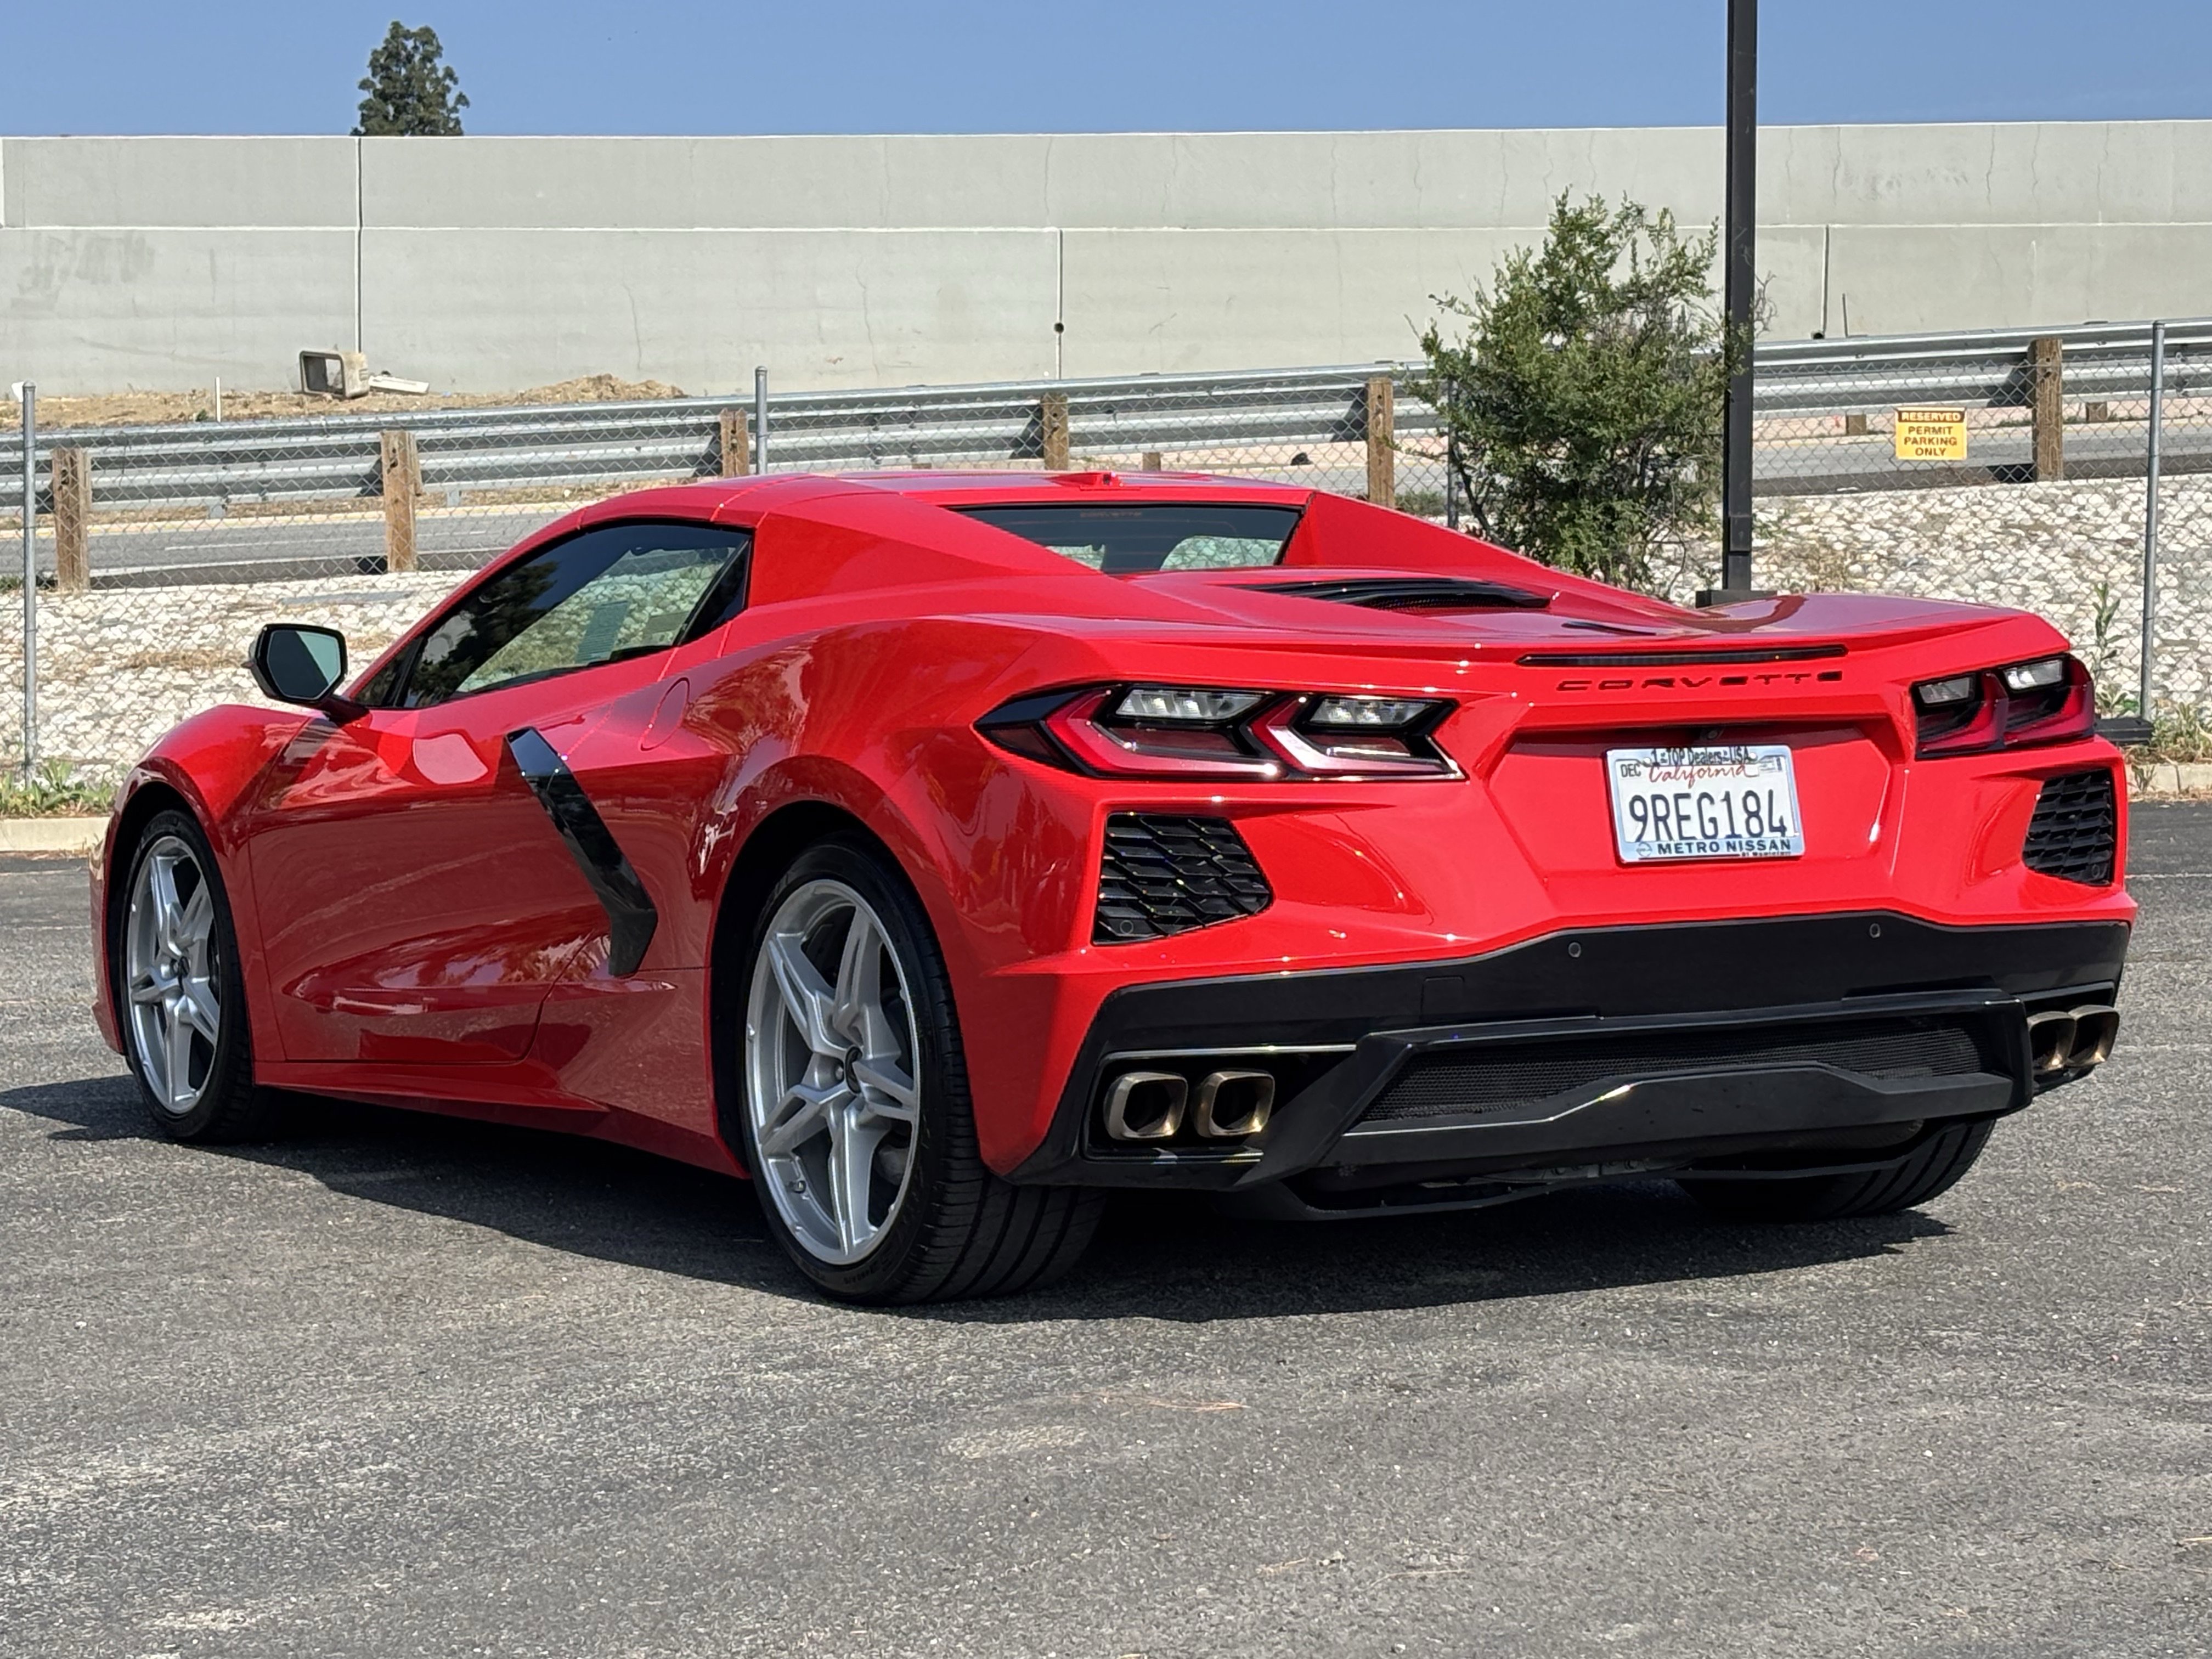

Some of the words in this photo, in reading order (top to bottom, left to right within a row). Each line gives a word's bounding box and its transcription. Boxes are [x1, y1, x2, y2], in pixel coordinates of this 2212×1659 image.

[1901, 412, 1961, 421] RESERVED
[1908, 426, 1953, 435] PERMIT
[1904, 436, 1957, 445] PARKING
[1915, 447, 1946, 456] ONLY
[1556, 670, 1843, 691] CORVETTE
[1620, 763, 1641, 778] DEC
[1649, 763, 1759, 789] California
[1628, 788, 1787, 843] 9REG184
[1657, 840, 1720, 855] METRO
[1726, 839, 1791, 853] NISSAN
